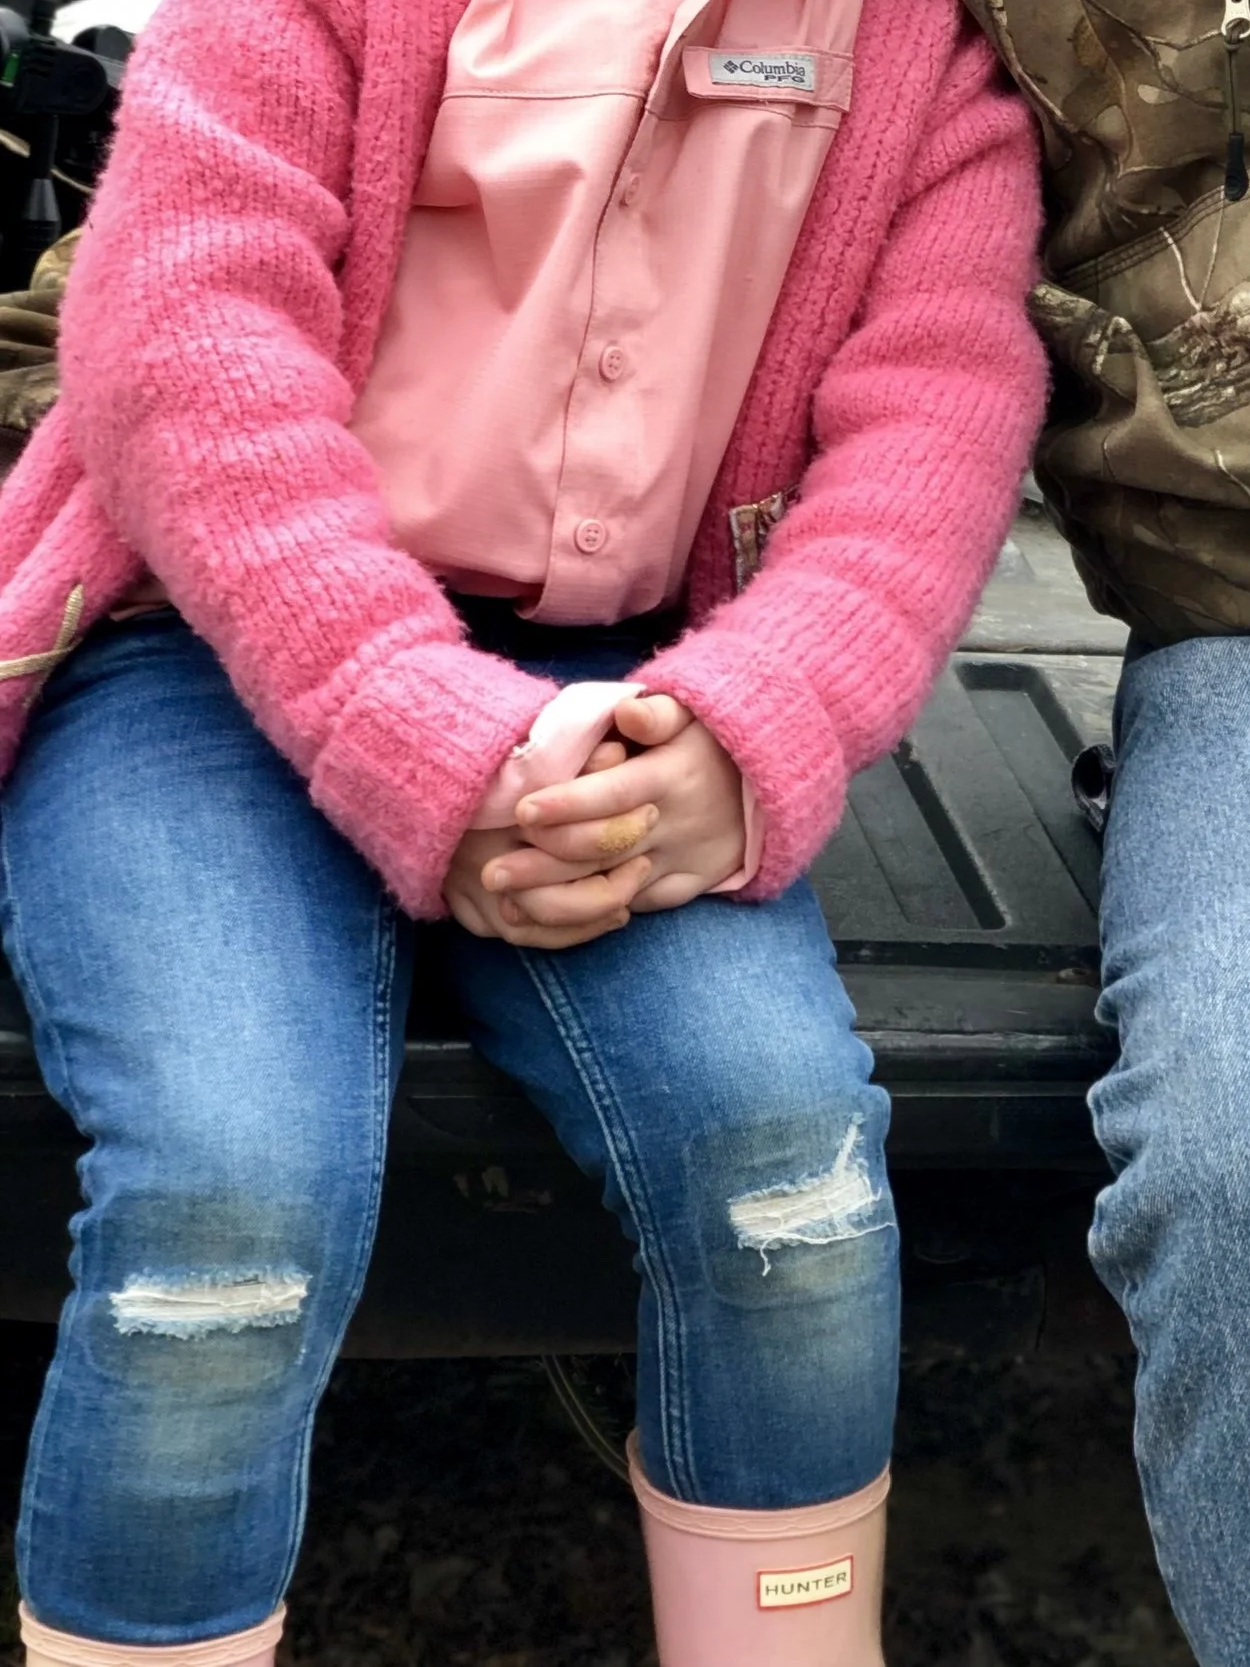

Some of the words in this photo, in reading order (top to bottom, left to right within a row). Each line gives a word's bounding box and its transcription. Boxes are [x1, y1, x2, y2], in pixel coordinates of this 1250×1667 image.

[739, 61, 806, 77] Columbia
[764, 75, 806, 84] PFG
[765, 1571, 847, 1596] HUNTER
